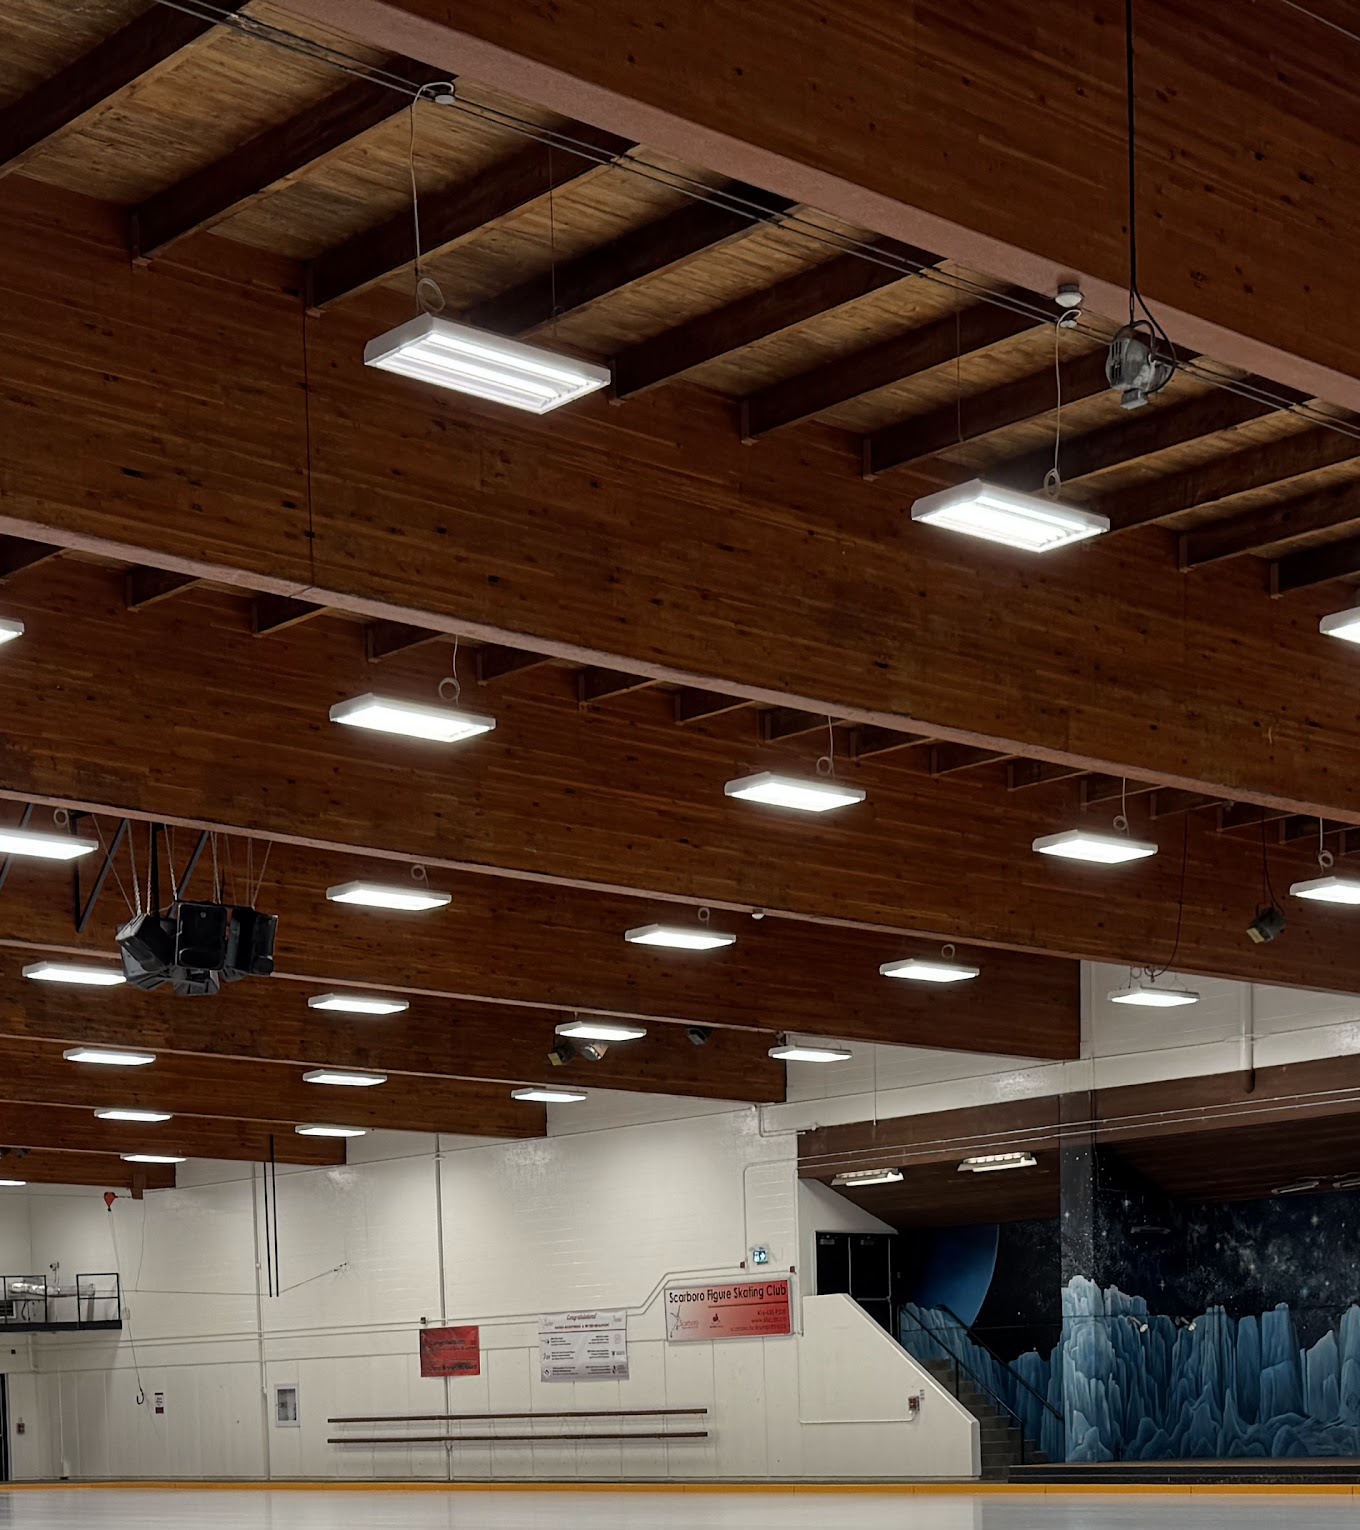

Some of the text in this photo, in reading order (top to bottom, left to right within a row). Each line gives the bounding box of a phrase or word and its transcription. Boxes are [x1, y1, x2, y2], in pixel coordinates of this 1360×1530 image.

[669, 1284, 787, 1304] Scarboro Figure Skating Club
